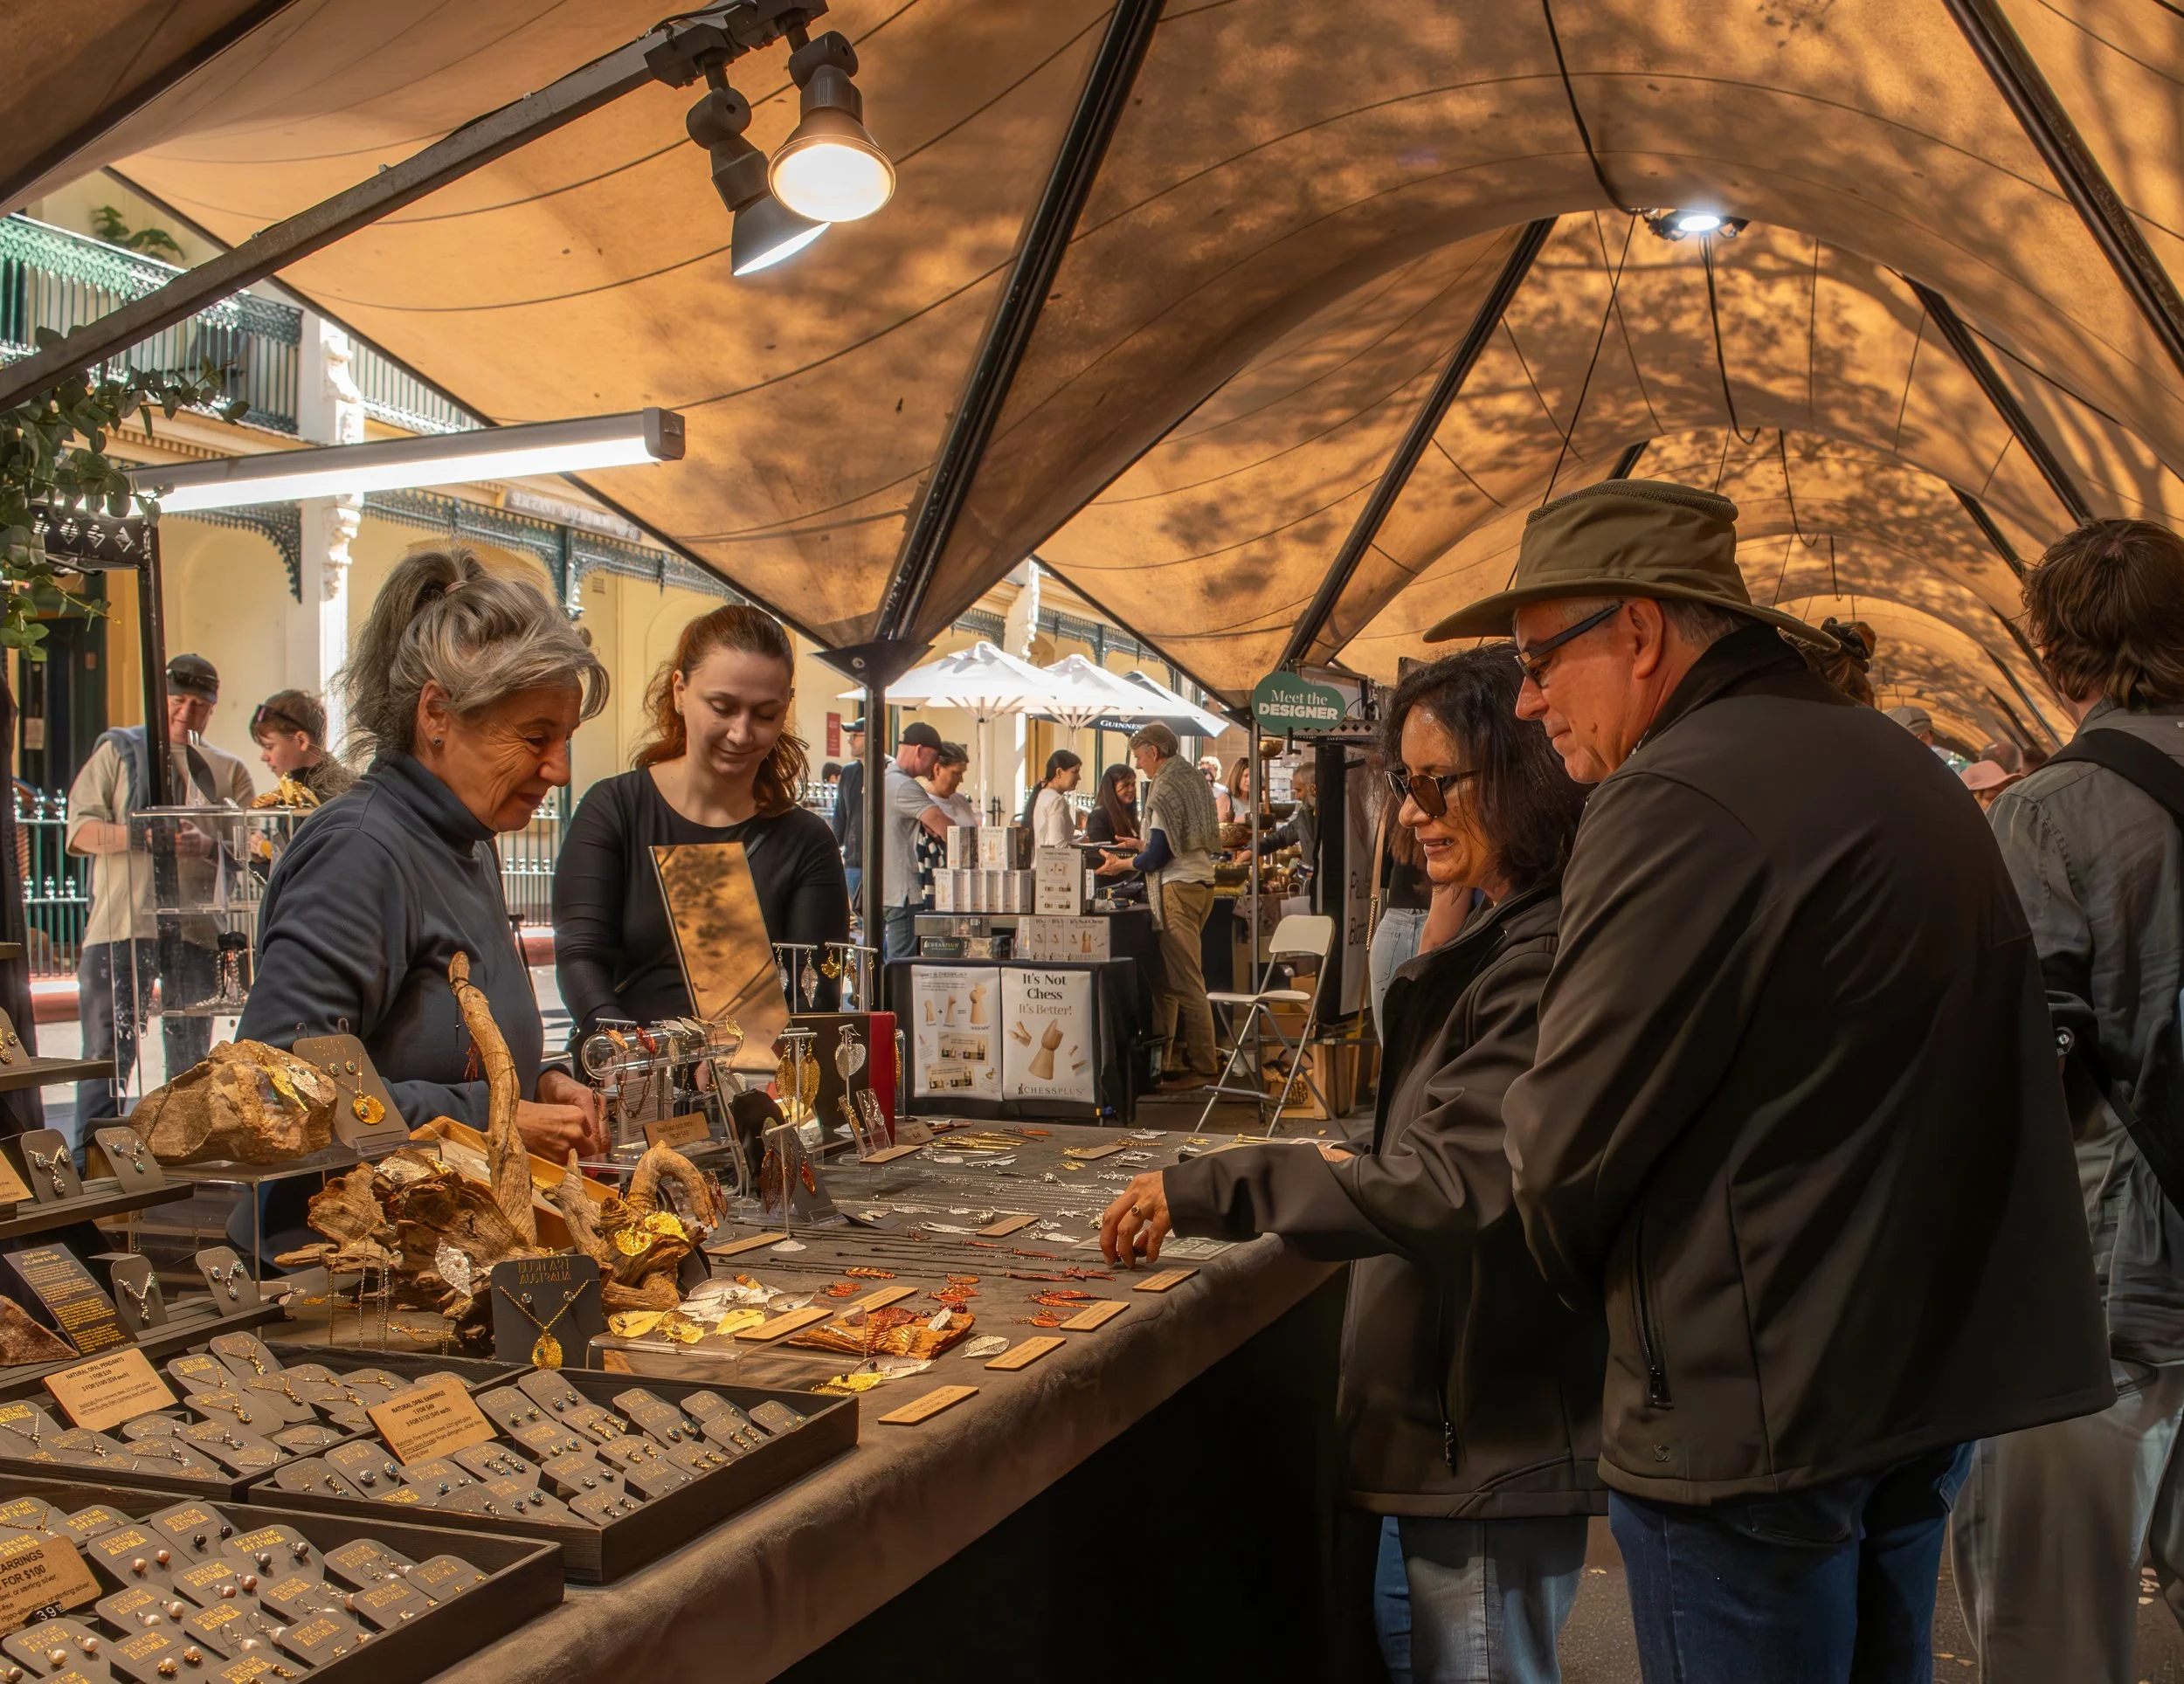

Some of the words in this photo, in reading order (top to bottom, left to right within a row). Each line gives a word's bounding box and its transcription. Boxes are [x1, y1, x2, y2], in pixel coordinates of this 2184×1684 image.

[1271, 689, 1305, 704] Meet
[1307, 691, 1328, 706] the
[1258, 701, 1338, 721] DESIGNER
[1022, 973, 1040, 985] It's
[1045, 973, 1067, 985] Not
[1026, 988, 1063, 1000] Chess
[1019, 1004, 1034, 1015] It's
[1036, 1004, 1072, 1015] Better!
[520, 1271, 572, 1285] AUSTRALIA
[66, 1369, 88, 1379] NATURAL
[100, 1356, 125, 1368] PENDANTS
[391, 1403, 413, 1413] NATURAL
[424, 1390, 446, 1401] EARRINGS
[0, 1549, 45, 1574] ARRINGS
[2, 1573, 24, 1588] FOR
[24, 1564, 45, 1579] $100
[20, 1580, 42, 1593] sterling
[55, 1588, 75, 1600] sterling
